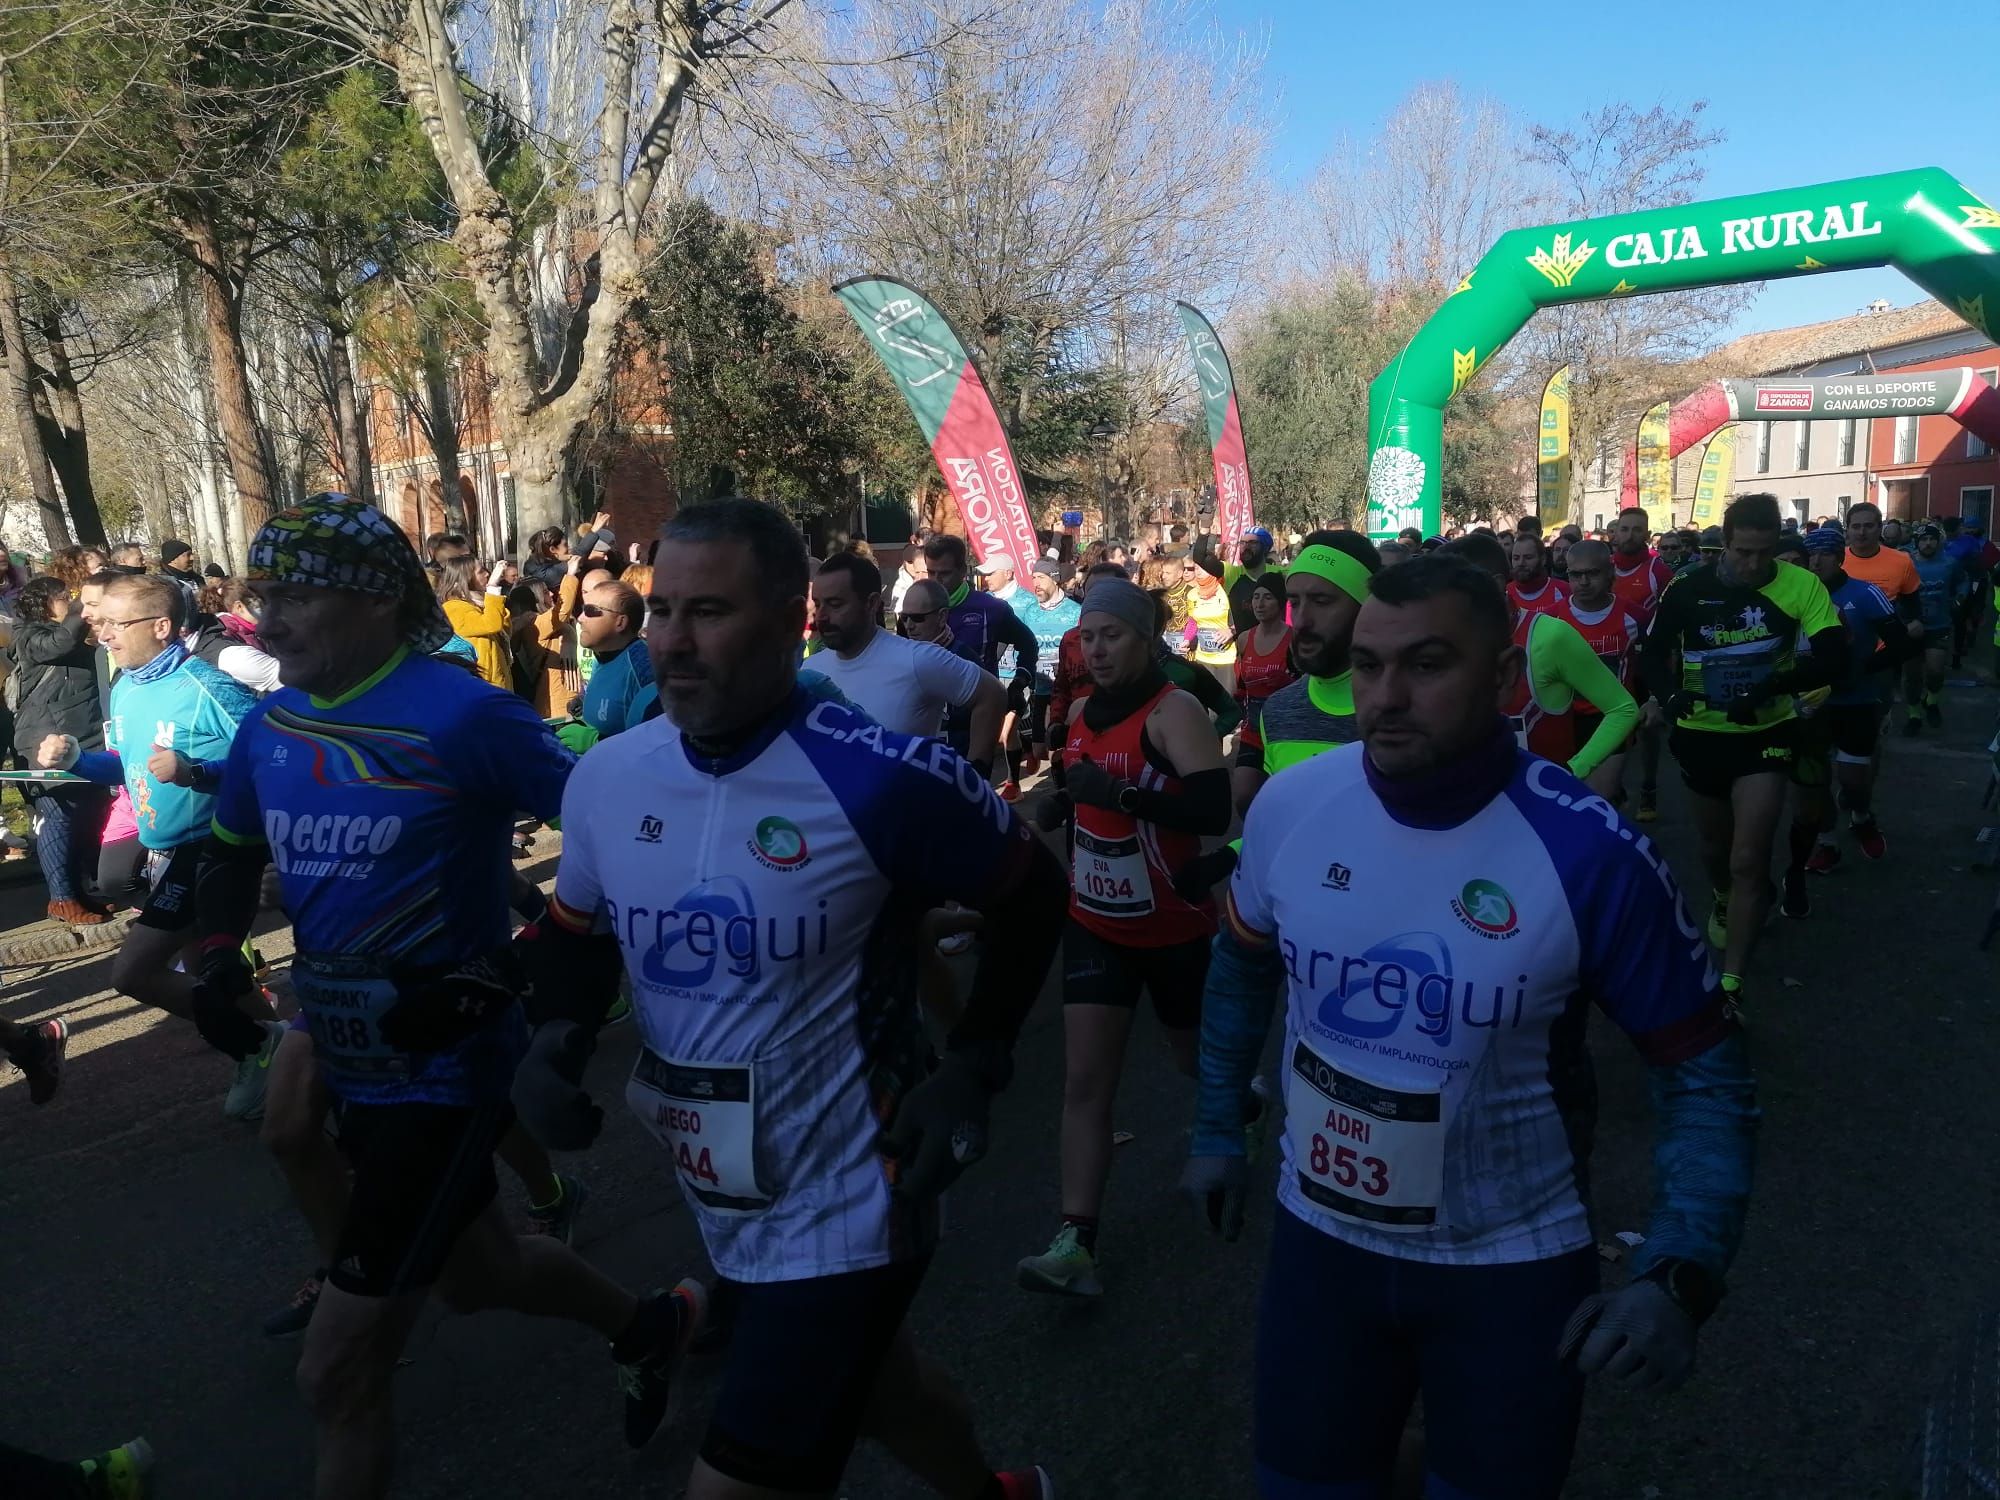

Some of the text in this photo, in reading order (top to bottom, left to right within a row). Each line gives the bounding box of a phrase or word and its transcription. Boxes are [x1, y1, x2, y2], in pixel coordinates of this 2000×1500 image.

[1605, 201, 1882, 268] CAJA RURAL
[1769, 399, 1810, 407] ZAMORA
[1823, 396, 1936, 411] GANAMOS TODOS
[1824, 381, 1937, 396] CON EL DEPORTE
[1310, 552, 1336, 567] GORE
[265, 809, 403, 874] Recreo
[1093, 858, 1111, 874] EVA
[1084, 871, 1134, 899] 1034
[1450, 899, 1462, 918] CLUB
[1460, 917, 1499, 940] ATLETISMO
[1283, 938, 1528, 1036] arregui
[1309, 1019, 1370, 1052] PERIODONCIA
[1325, 1109, 1371, 1145] ADRI
[1310, 1132, 1390, 1197] 853
